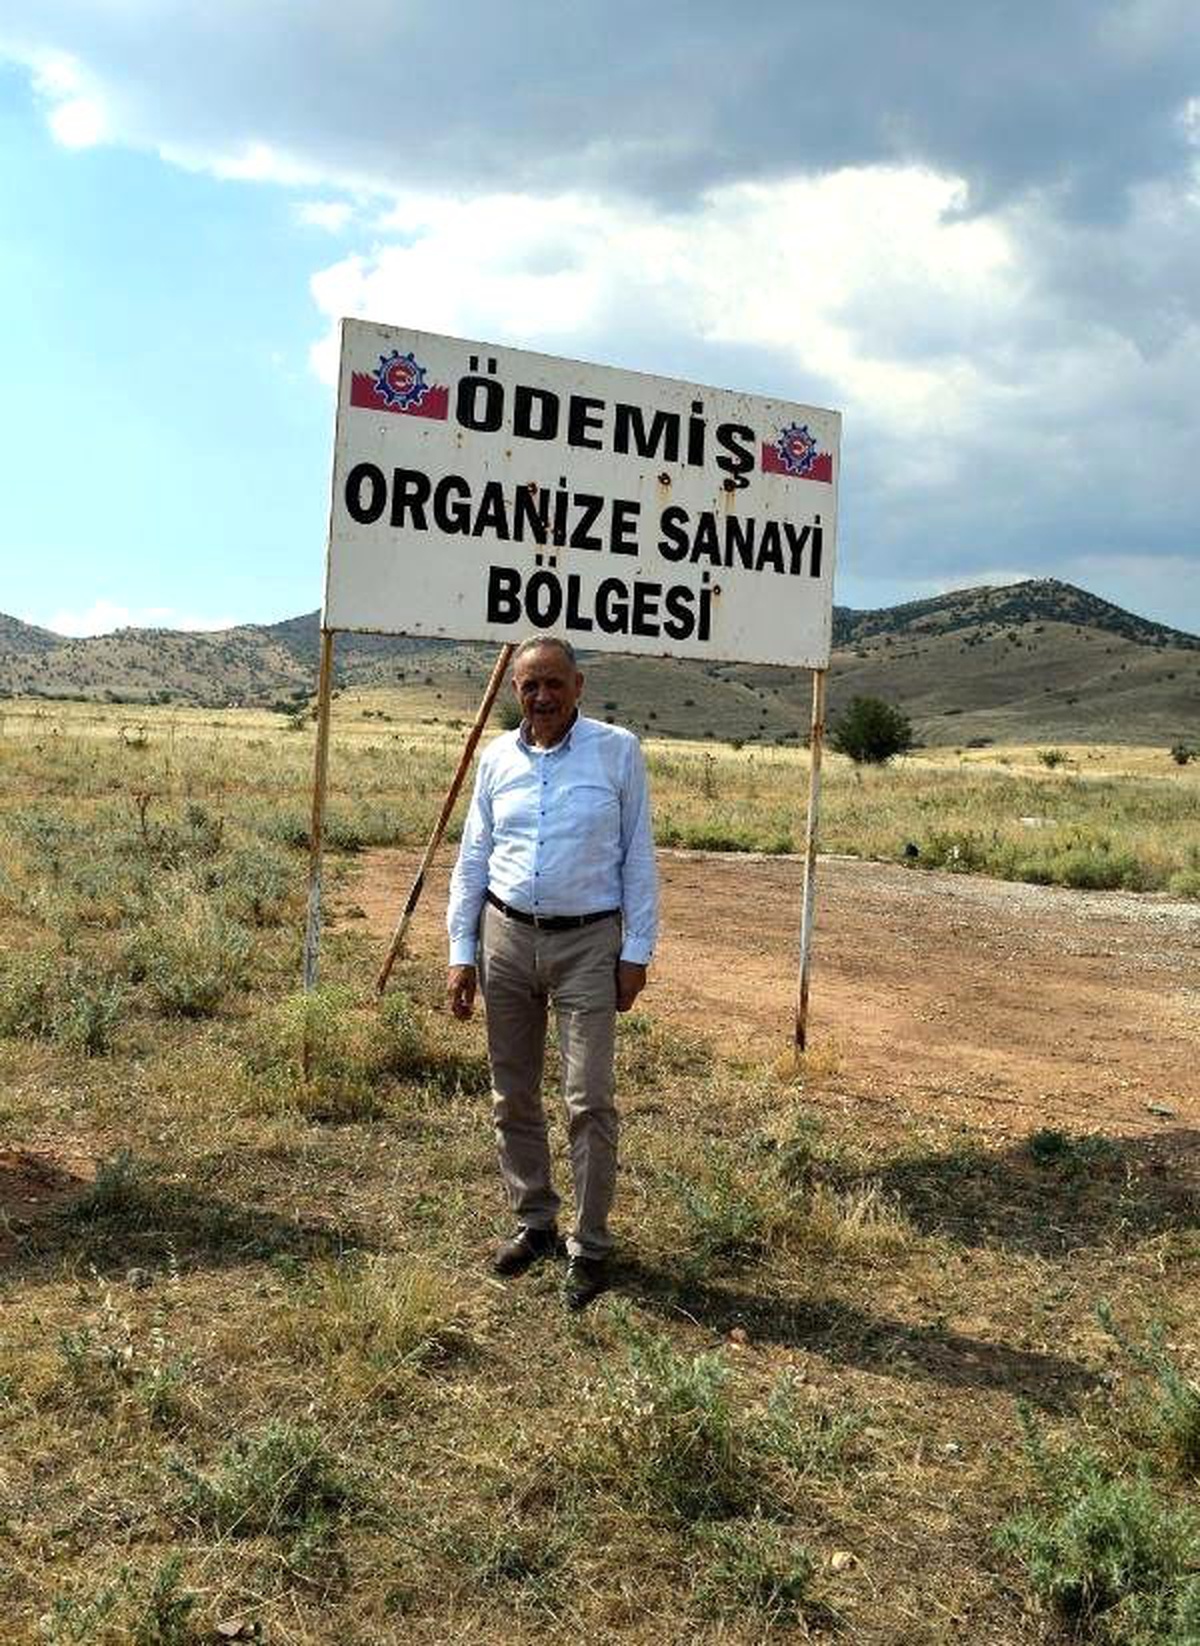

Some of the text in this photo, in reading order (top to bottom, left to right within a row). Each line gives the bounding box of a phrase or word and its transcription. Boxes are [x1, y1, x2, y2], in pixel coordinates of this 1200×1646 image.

[455, 355, 755, 488] ÖDEMİŞ
[345, 462, 823, 578] ORGANİZE SANAYİ
[487, 554, 711, 640] BÖLGESİ
